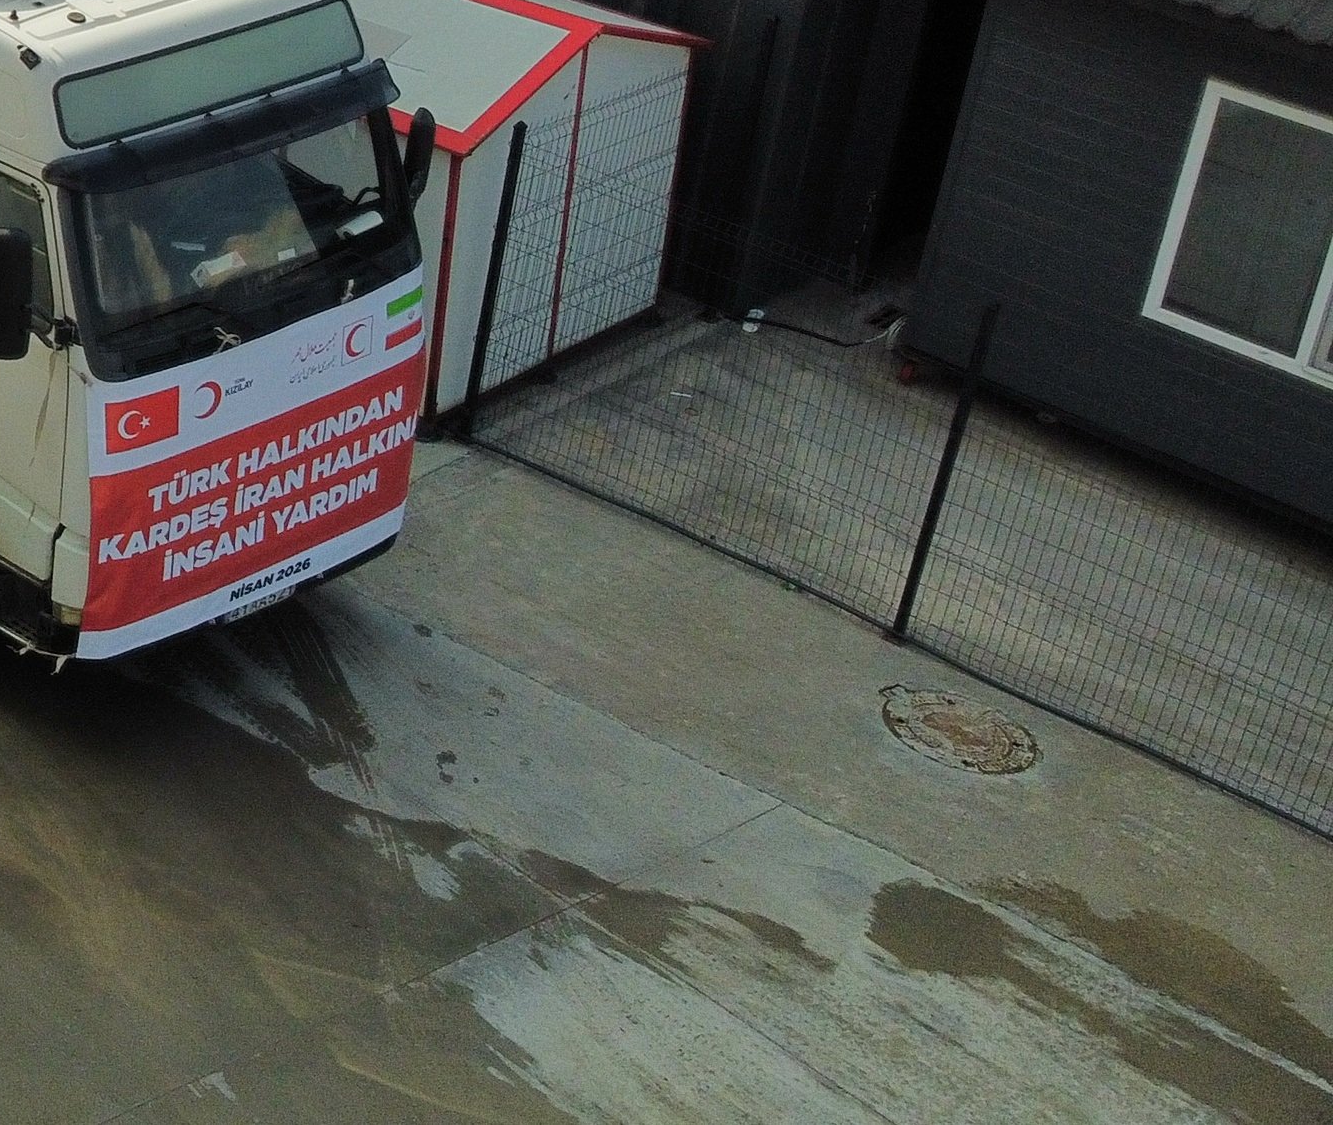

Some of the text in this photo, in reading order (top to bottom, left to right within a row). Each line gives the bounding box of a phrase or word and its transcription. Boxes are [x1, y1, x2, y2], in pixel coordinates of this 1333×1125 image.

[148, 386, 404, 512] TÜRK HALKINDAN
[98, 497, 229, 564] KARDEŞ
[234, 464, 306, 516] İRAN
[163, 468, 379, 582] İNSANİ YARDIM
[229, 558, 311, 602] NİSAN 2026
